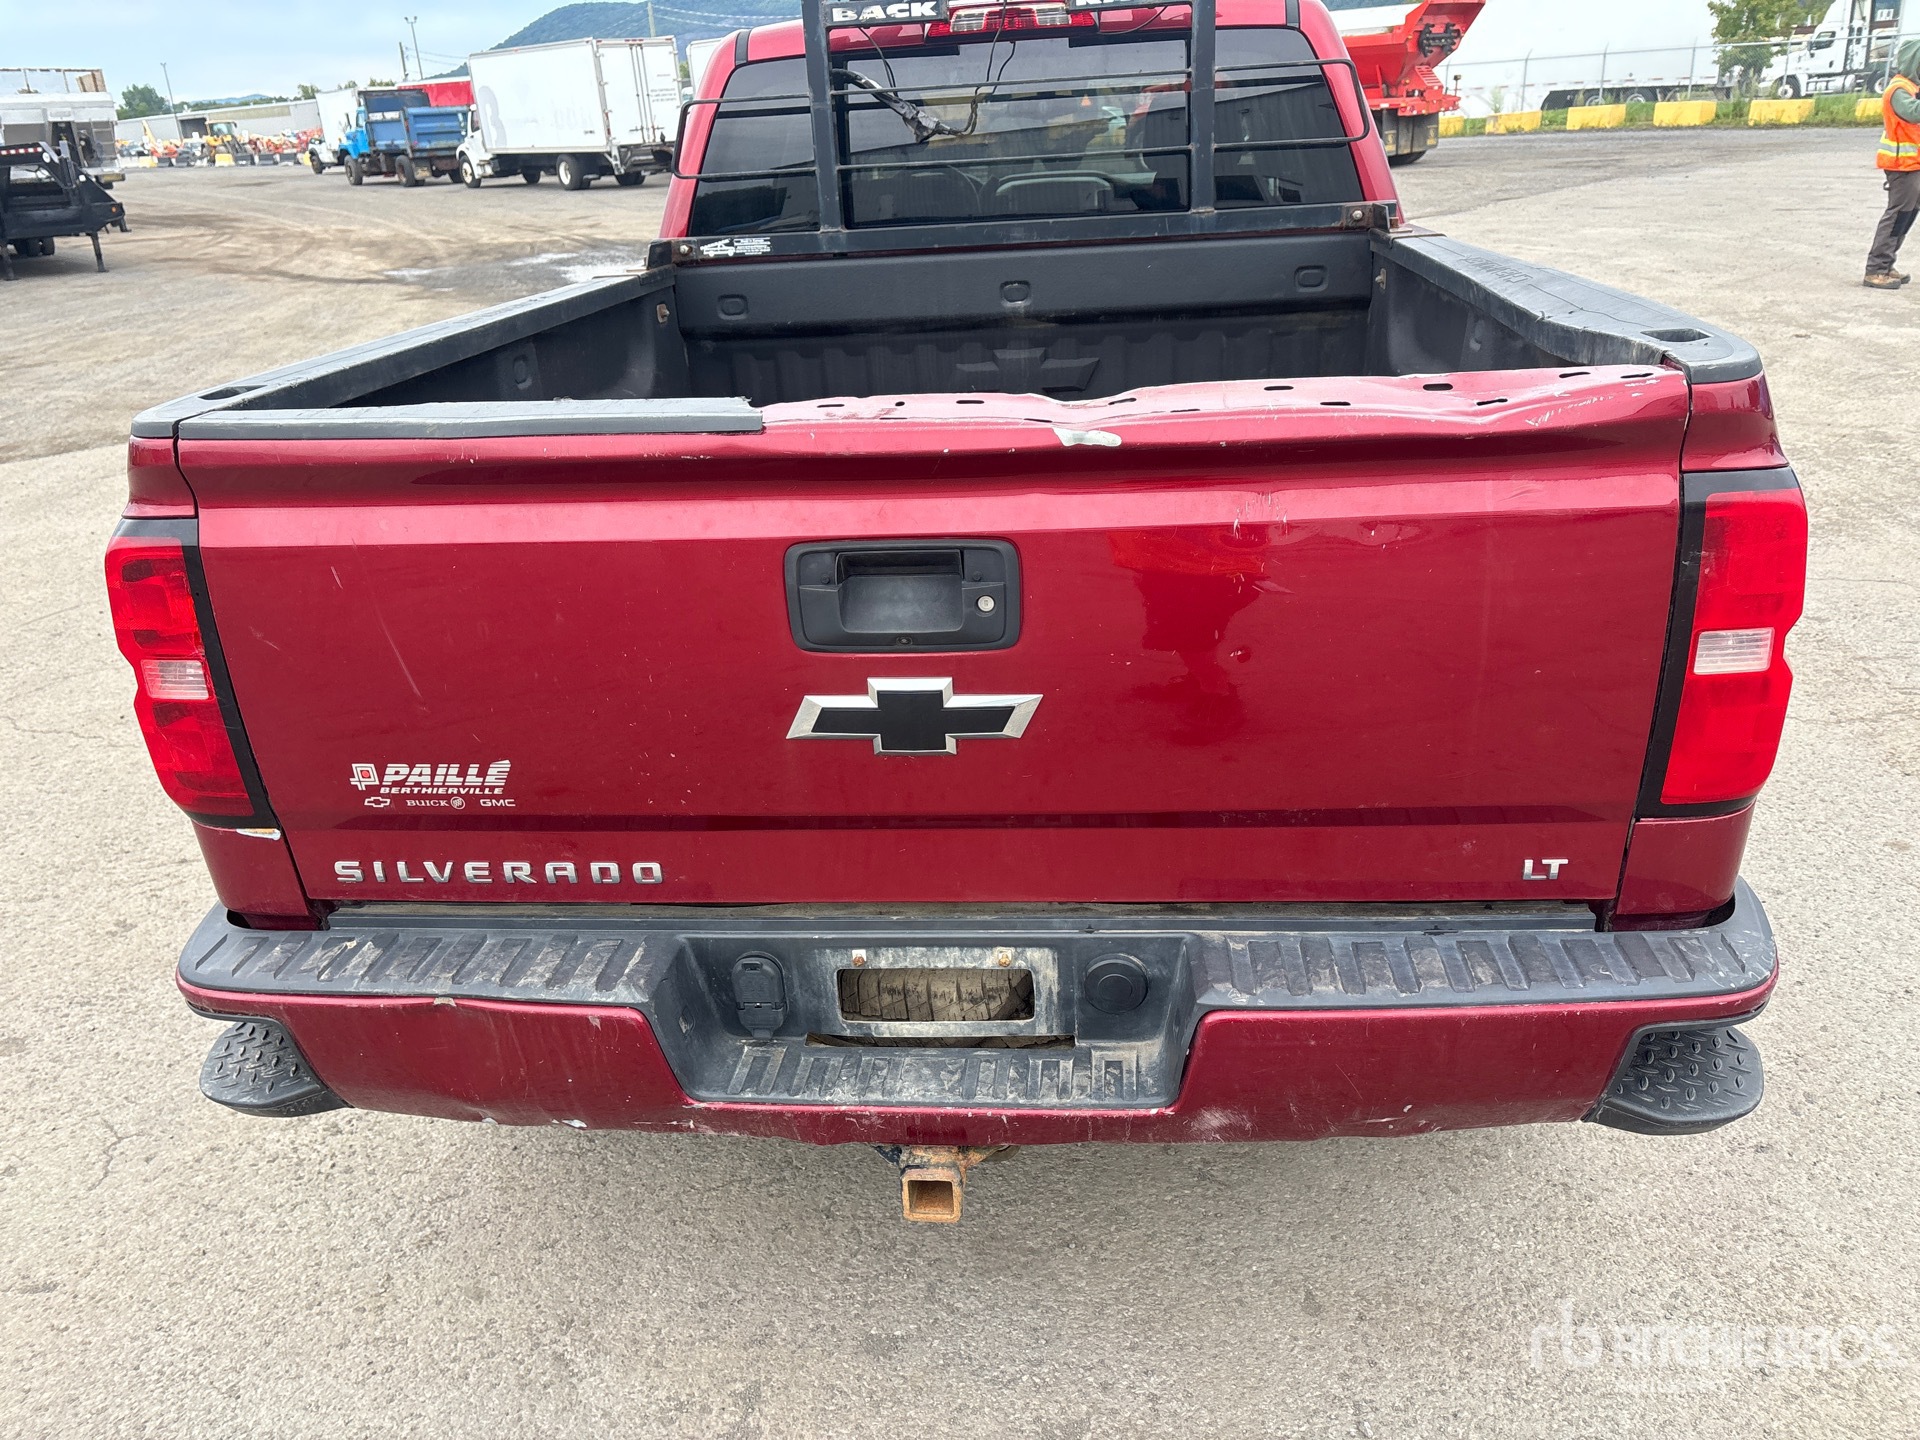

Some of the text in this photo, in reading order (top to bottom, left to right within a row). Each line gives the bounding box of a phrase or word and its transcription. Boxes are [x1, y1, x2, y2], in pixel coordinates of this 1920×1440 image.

[832, 1, 937, 22] BACK
[382, 759, 511, 785] PAILLÉ
[405, 799, 516, 807] BUICK GMC
[334, 860, 664, 885] SILVERADO
[1522, 858, 1569, 880] LT
